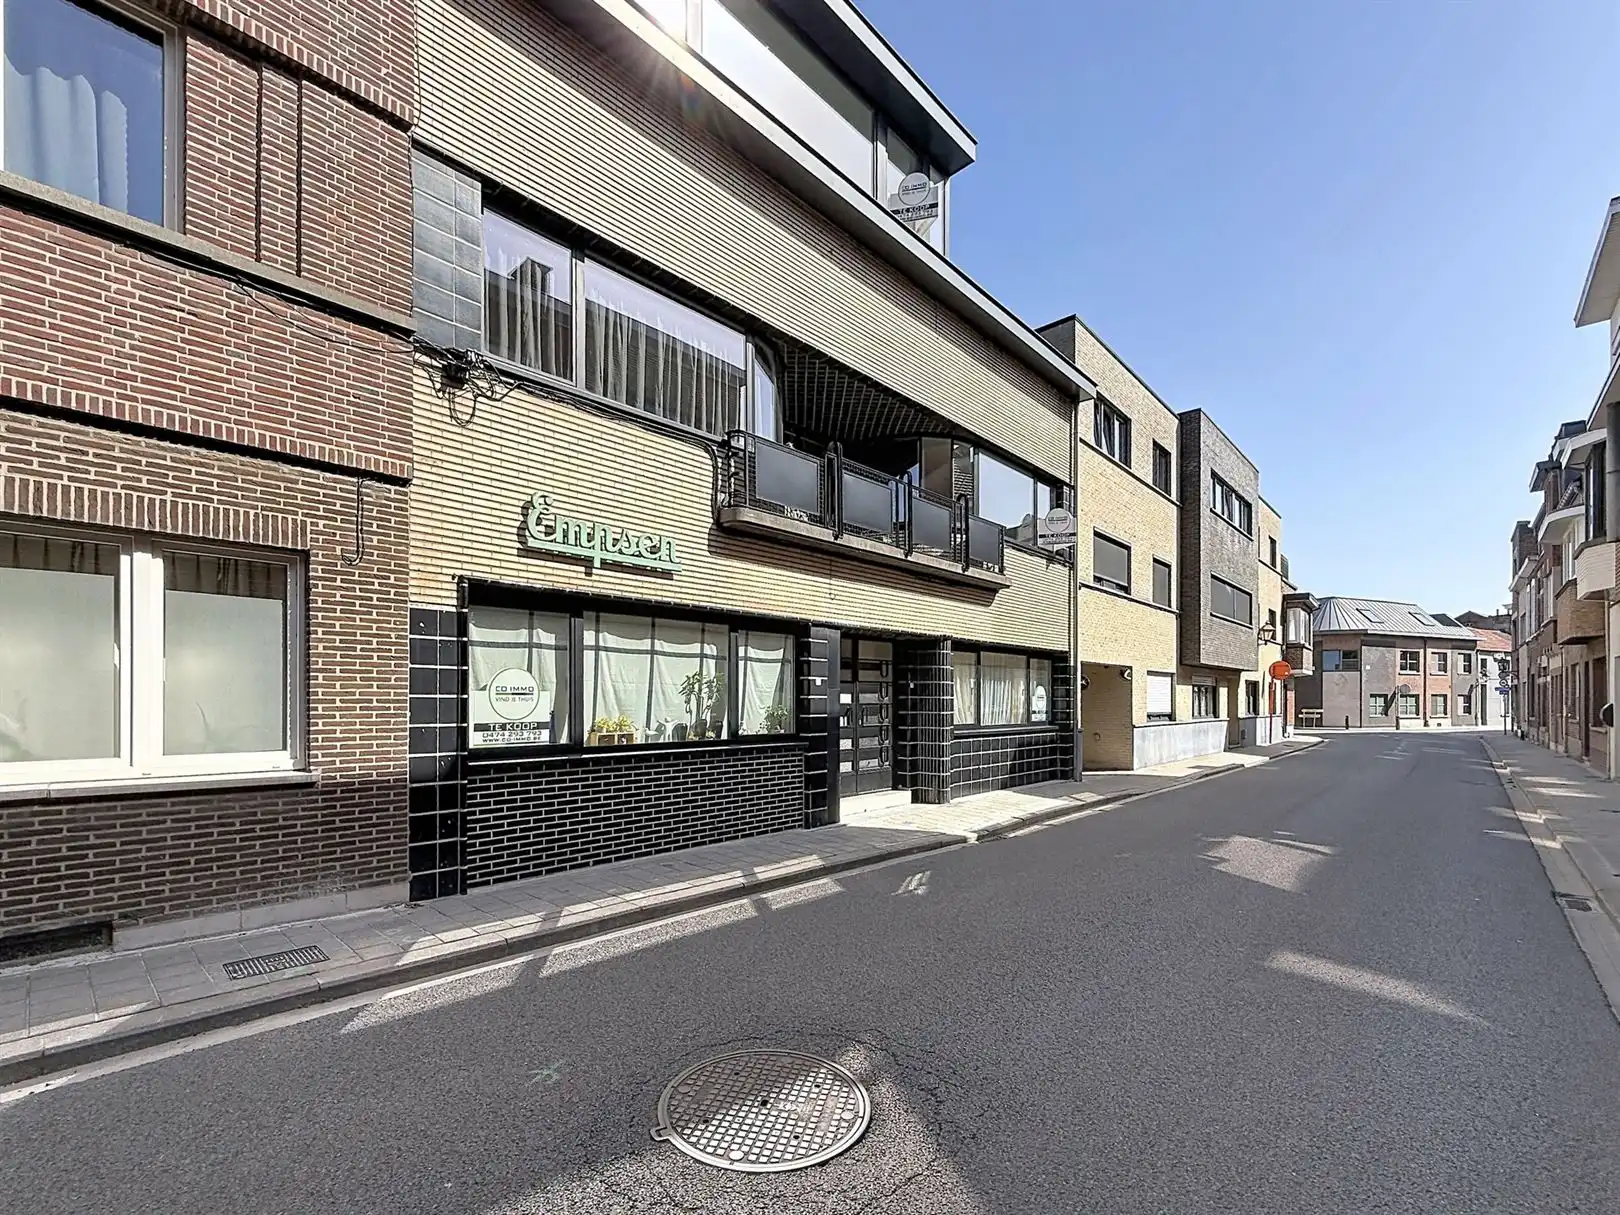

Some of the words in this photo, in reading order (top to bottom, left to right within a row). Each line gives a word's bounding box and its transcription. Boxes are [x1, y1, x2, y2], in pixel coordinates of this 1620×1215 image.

[527, 491, 682, 569] Empsen
[488, 723, 503, 731] TE
[506, 722, 538, 731] KOOP
[482, 731, 505, 739] 0474
